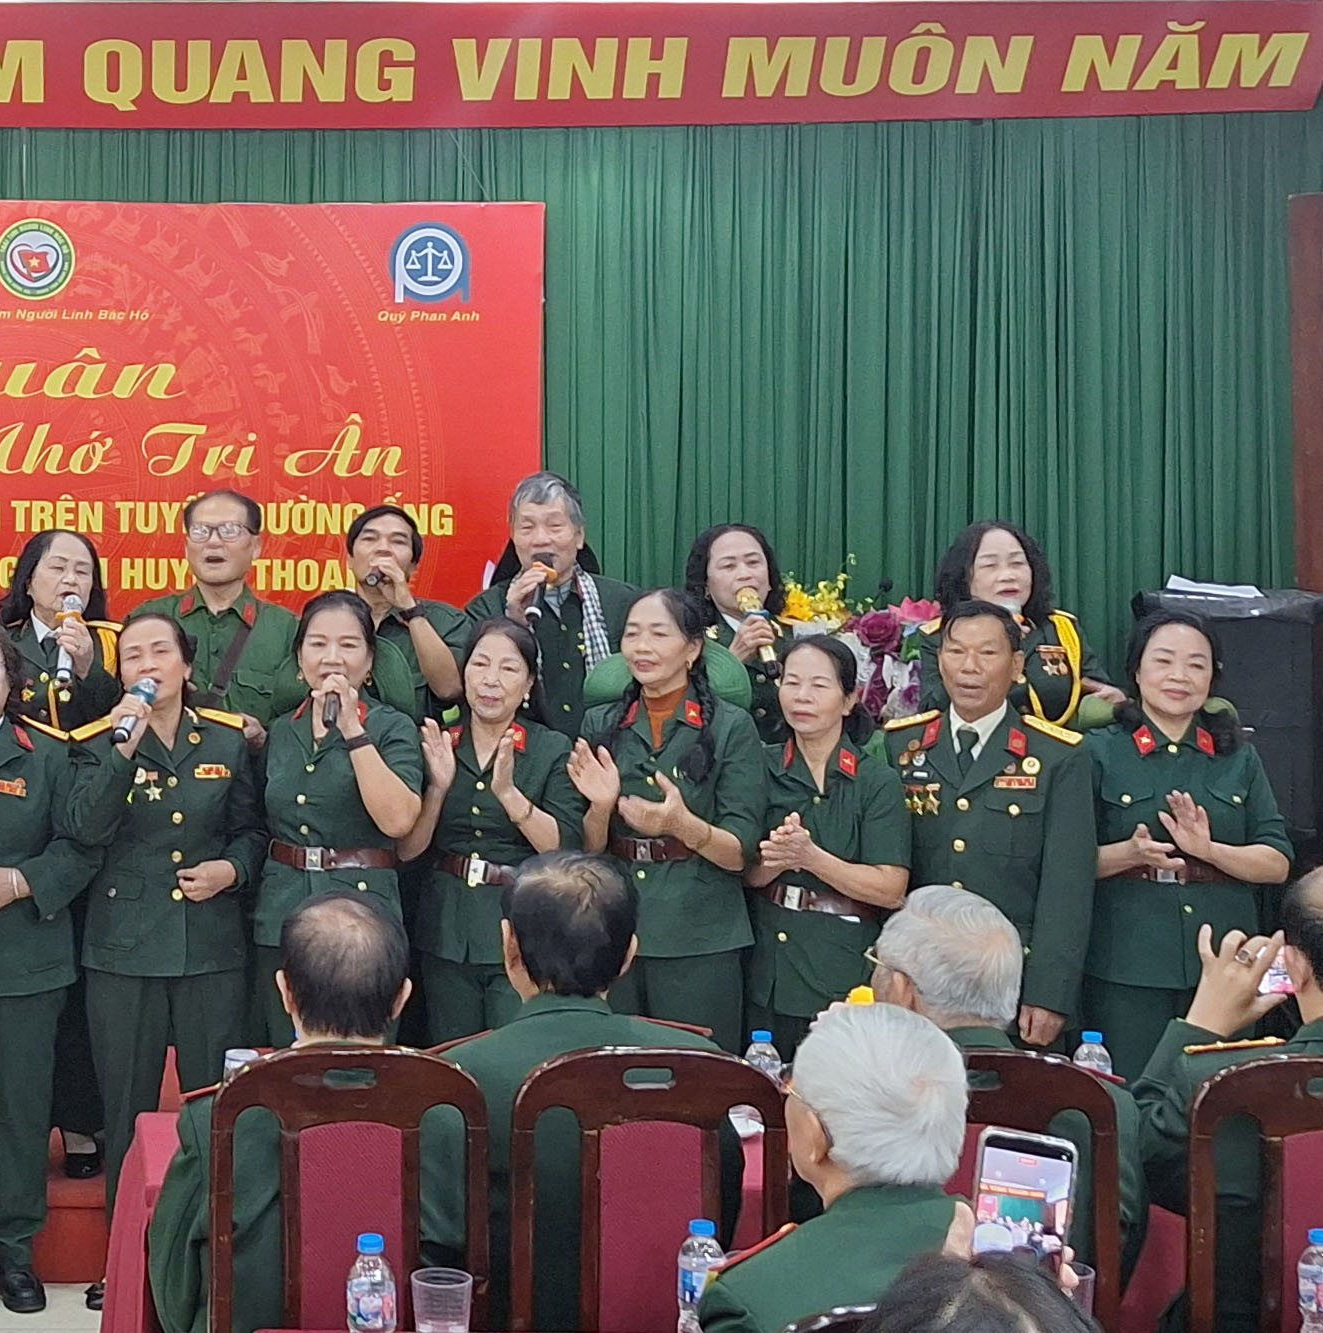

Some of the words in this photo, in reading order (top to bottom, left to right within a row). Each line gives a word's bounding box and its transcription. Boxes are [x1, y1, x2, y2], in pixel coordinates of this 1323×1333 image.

[83, 38, 415, 111] QUANG
[451, 36, 688, 101] VINH
[721, 22, 1033, 97] MUÔN
[1061, 21, 1310, 92] NĂM
[410, 310, 447, 322] Phan
[450, 310, 480, 321] Anh
[141, 422, 260, 477] Tri
[284, 413, 409, 477] Ân
[10, 493, 104, 534] TRÊN
